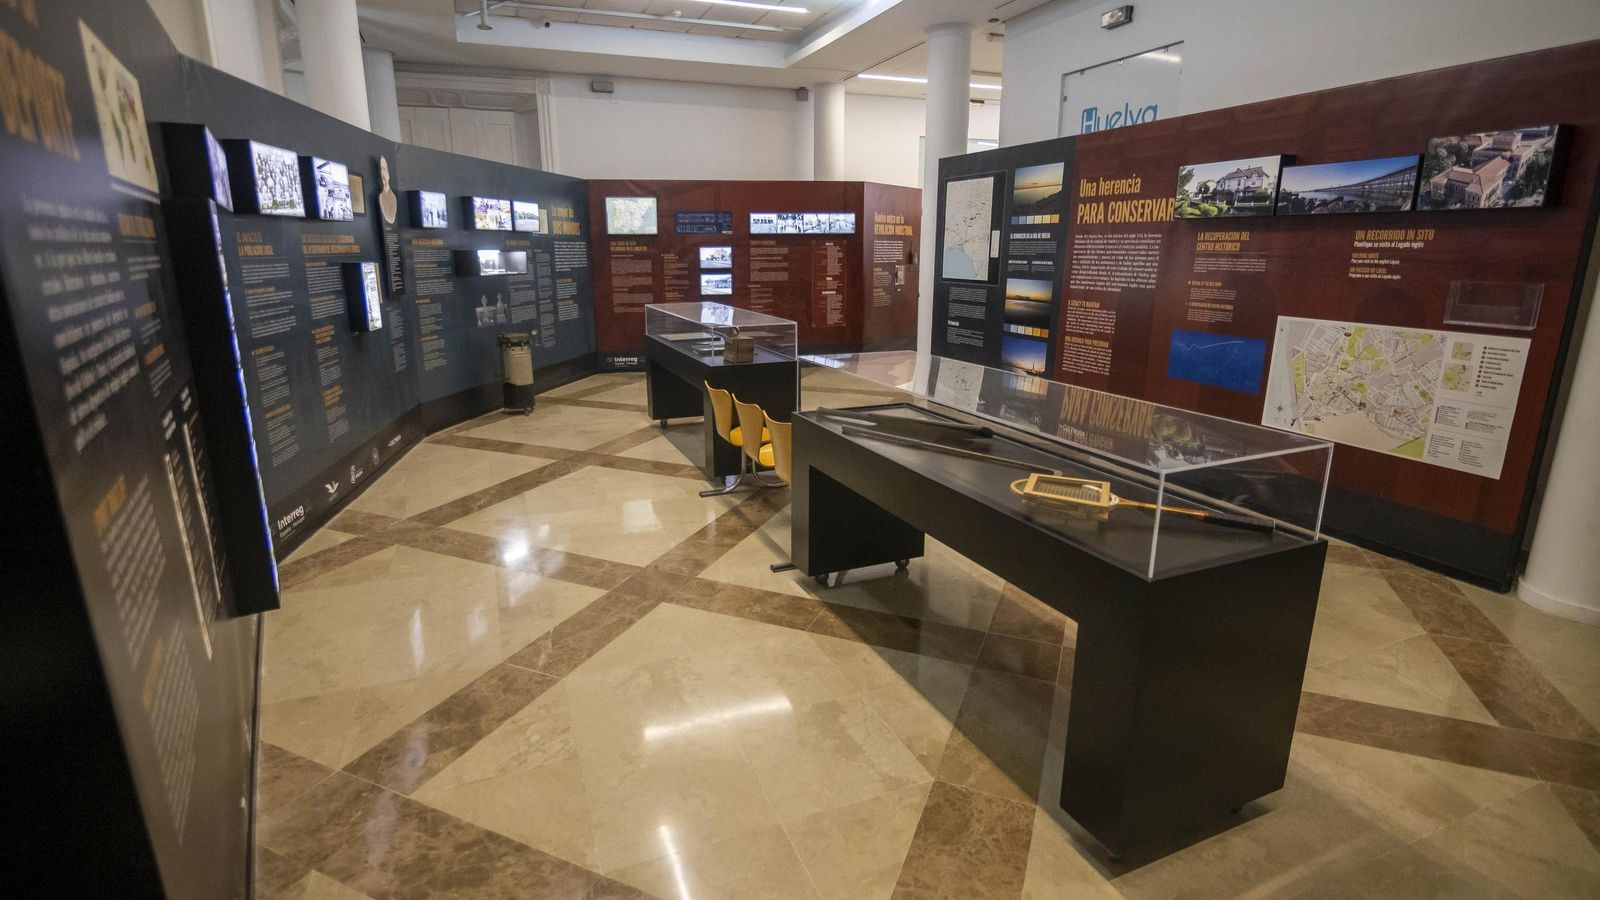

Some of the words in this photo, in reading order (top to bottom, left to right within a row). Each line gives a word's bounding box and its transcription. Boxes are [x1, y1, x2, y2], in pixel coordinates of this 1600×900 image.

[1081, 102, 1158, 135] Huelva
[1080, 178, 1097, 198] Una
[1099, 174, 1141, 195] herencia
[1077, 203, 1105, 224] PARA
[1108, 198, 1175, 224] CONSERVAR
[1241, 232, 1250, 241] DEL
[1355, 230, 1366, 240] UN
[1366, 230, 1406, 240] RECORRIDO
[1406, 230, 1415, 240] IN
[1416, 229, 1435, 240] SITU
[278, 505, 304, 530] Interreg
